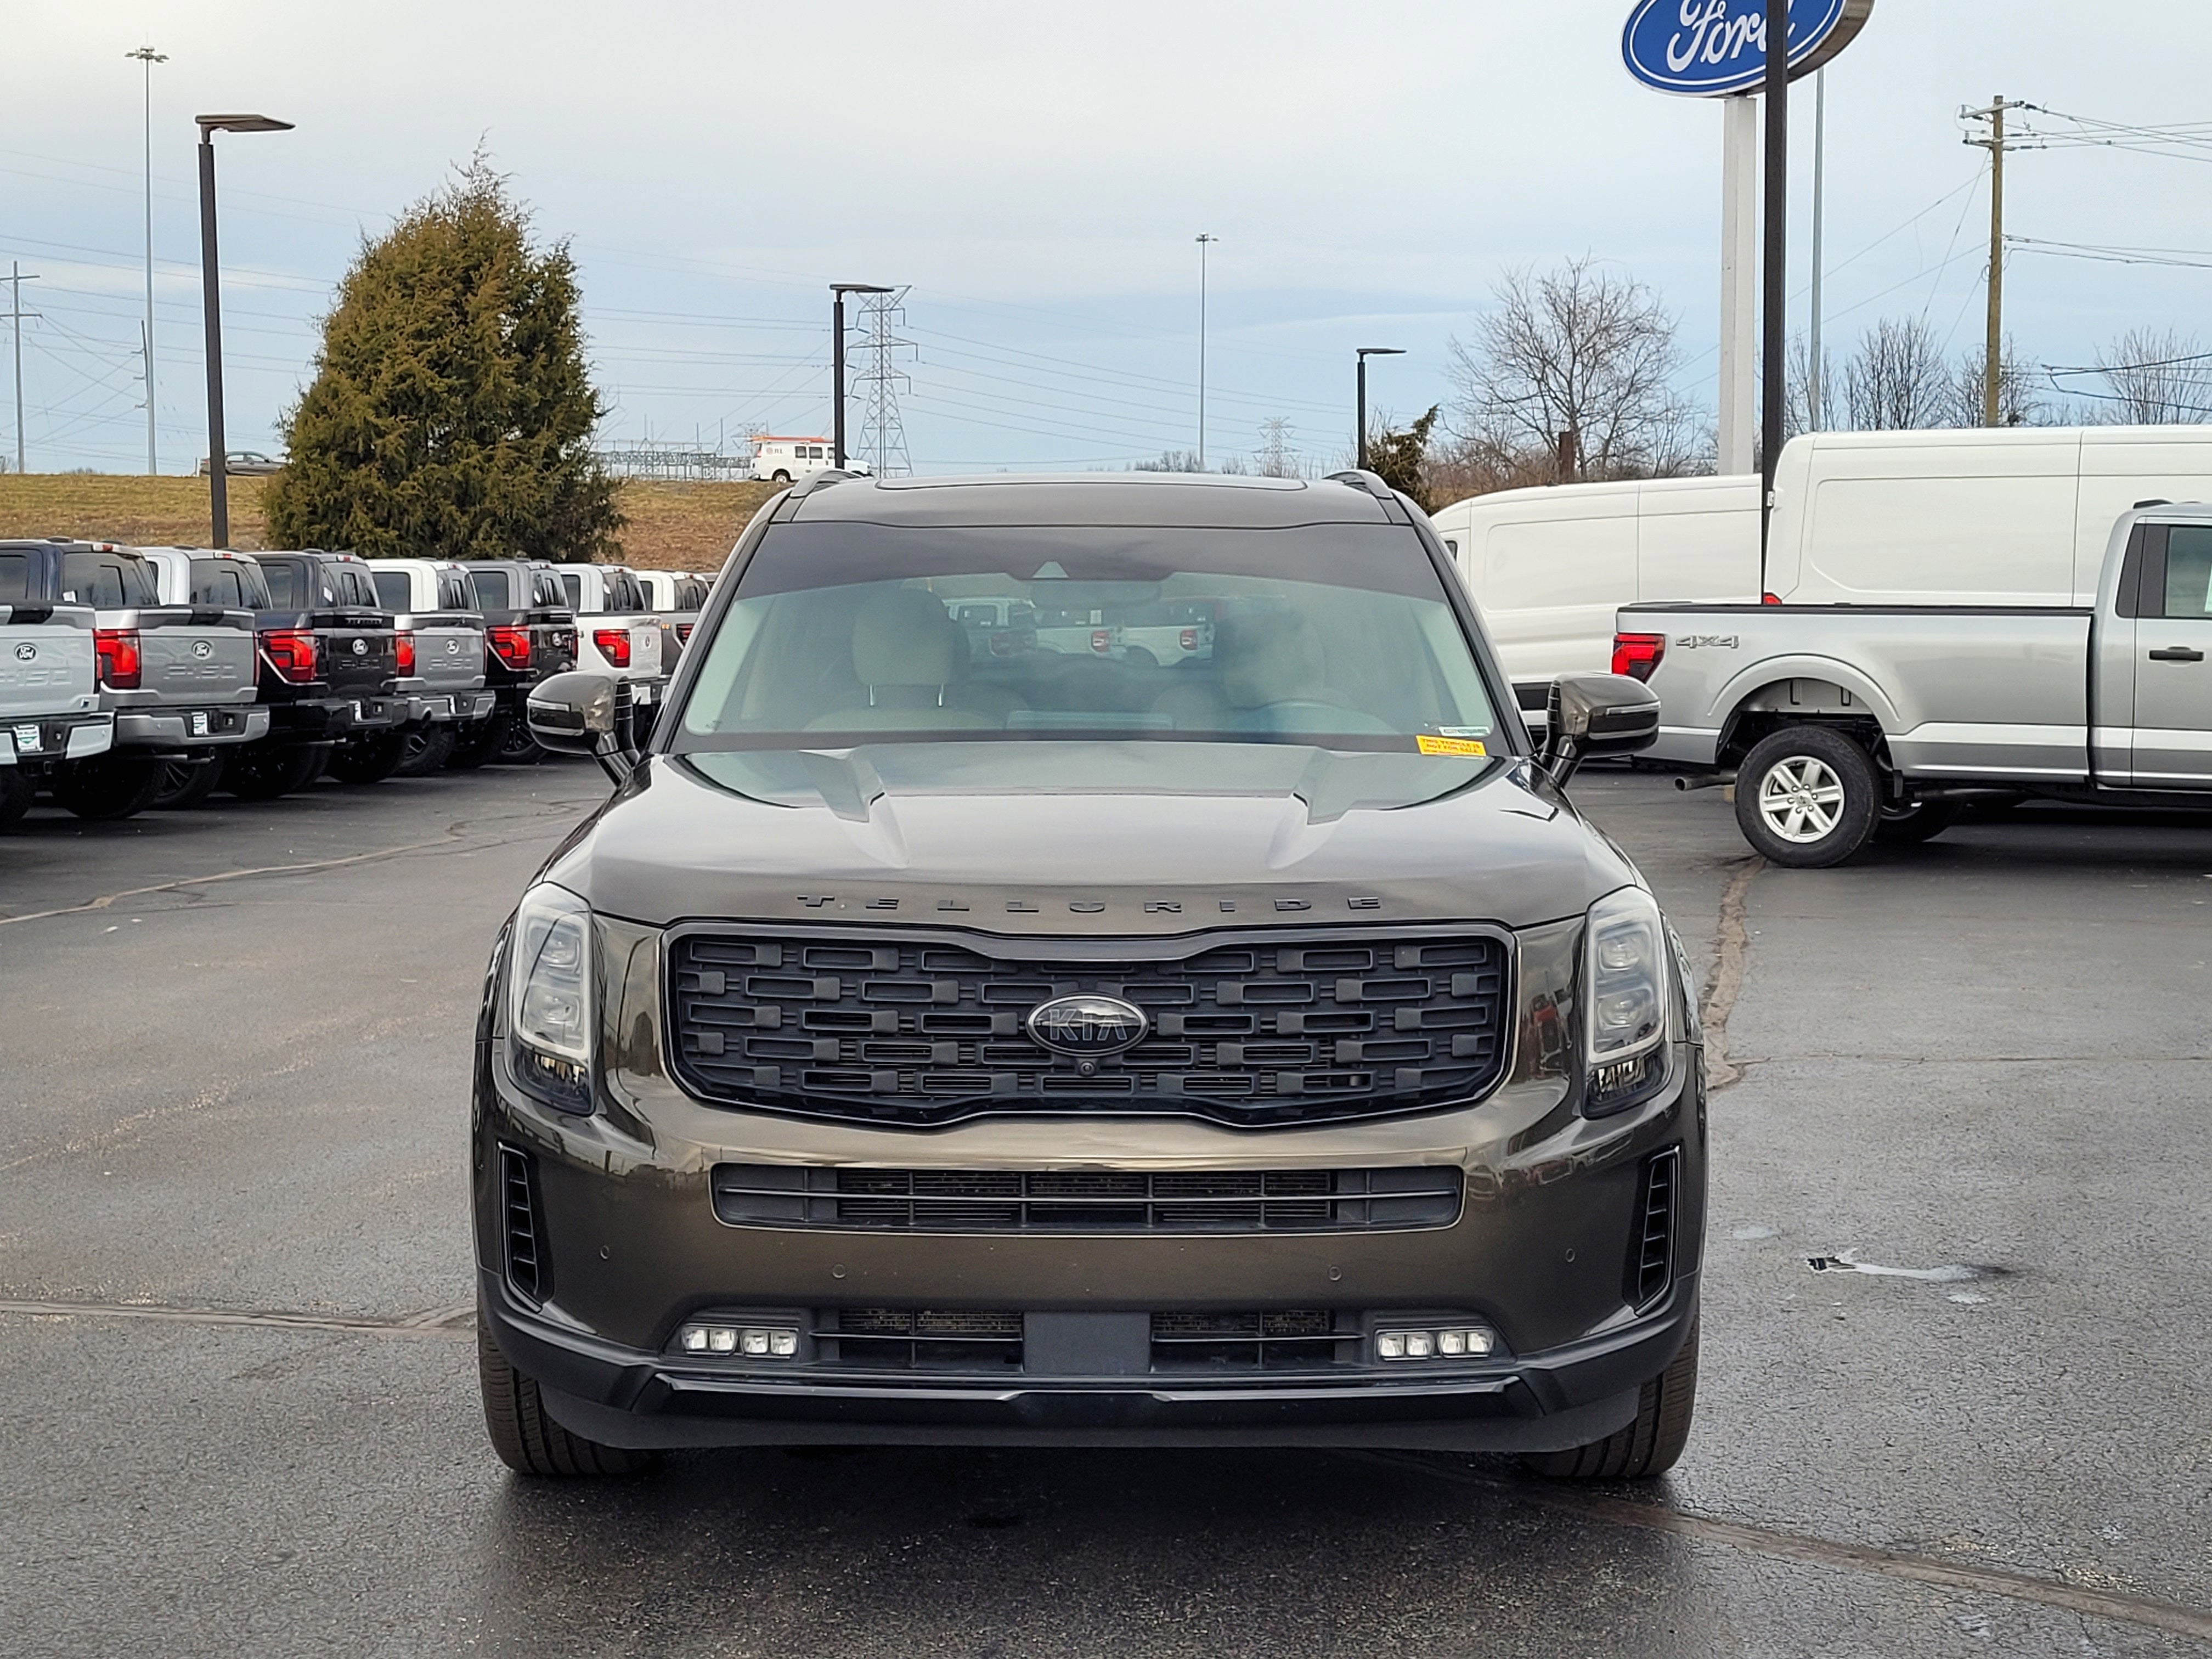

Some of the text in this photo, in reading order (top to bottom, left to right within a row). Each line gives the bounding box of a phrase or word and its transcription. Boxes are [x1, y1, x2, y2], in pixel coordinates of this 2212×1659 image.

[0, 667, 72, 686] -150
[163, 663, 238, 680] F-150
[797, 895, 1381, 913] TELLURIDE
[1049, 1008, 1127, 1041] KIA
